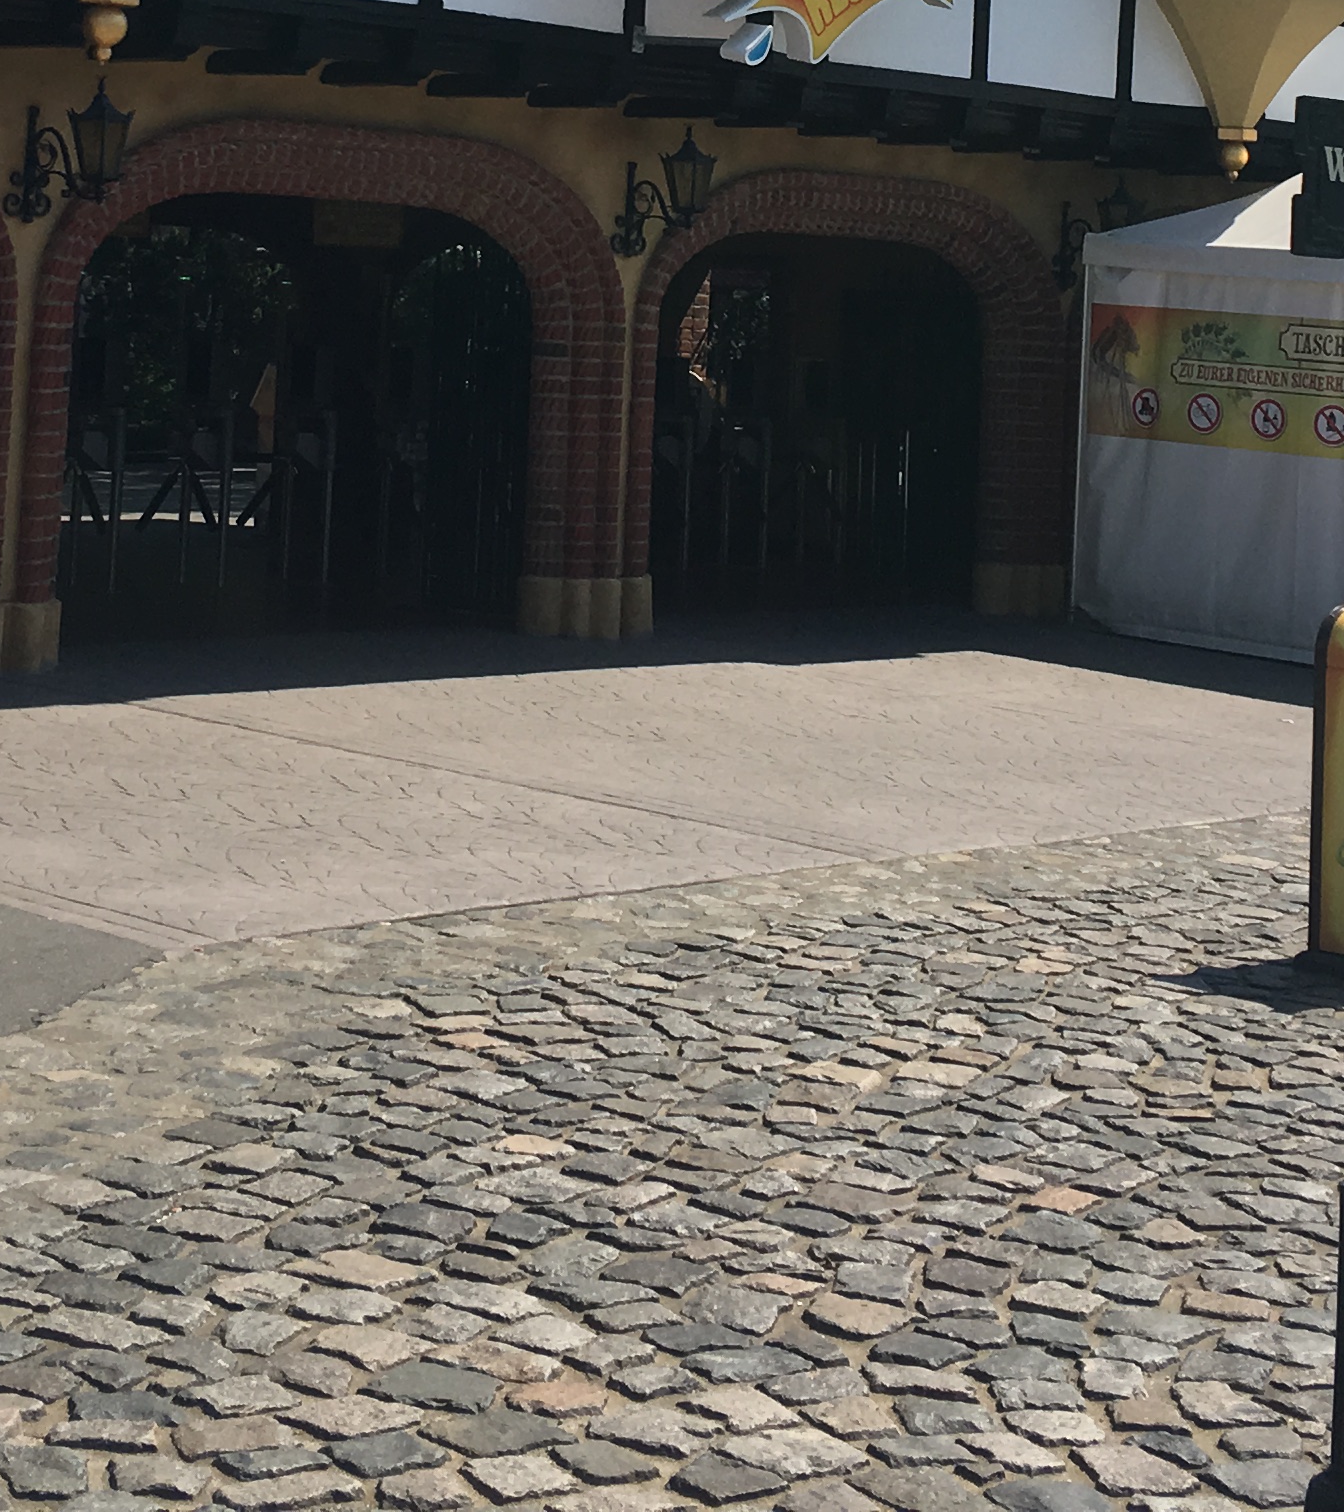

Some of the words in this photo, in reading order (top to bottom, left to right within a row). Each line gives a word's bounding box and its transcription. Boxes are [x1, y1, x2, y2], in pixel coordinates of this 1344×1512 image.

[1178, 362, 1194, 380] ZU
[1196, 365, 1234, 383] EURER
[1236, 368, 1290, 388] EIGENEN
